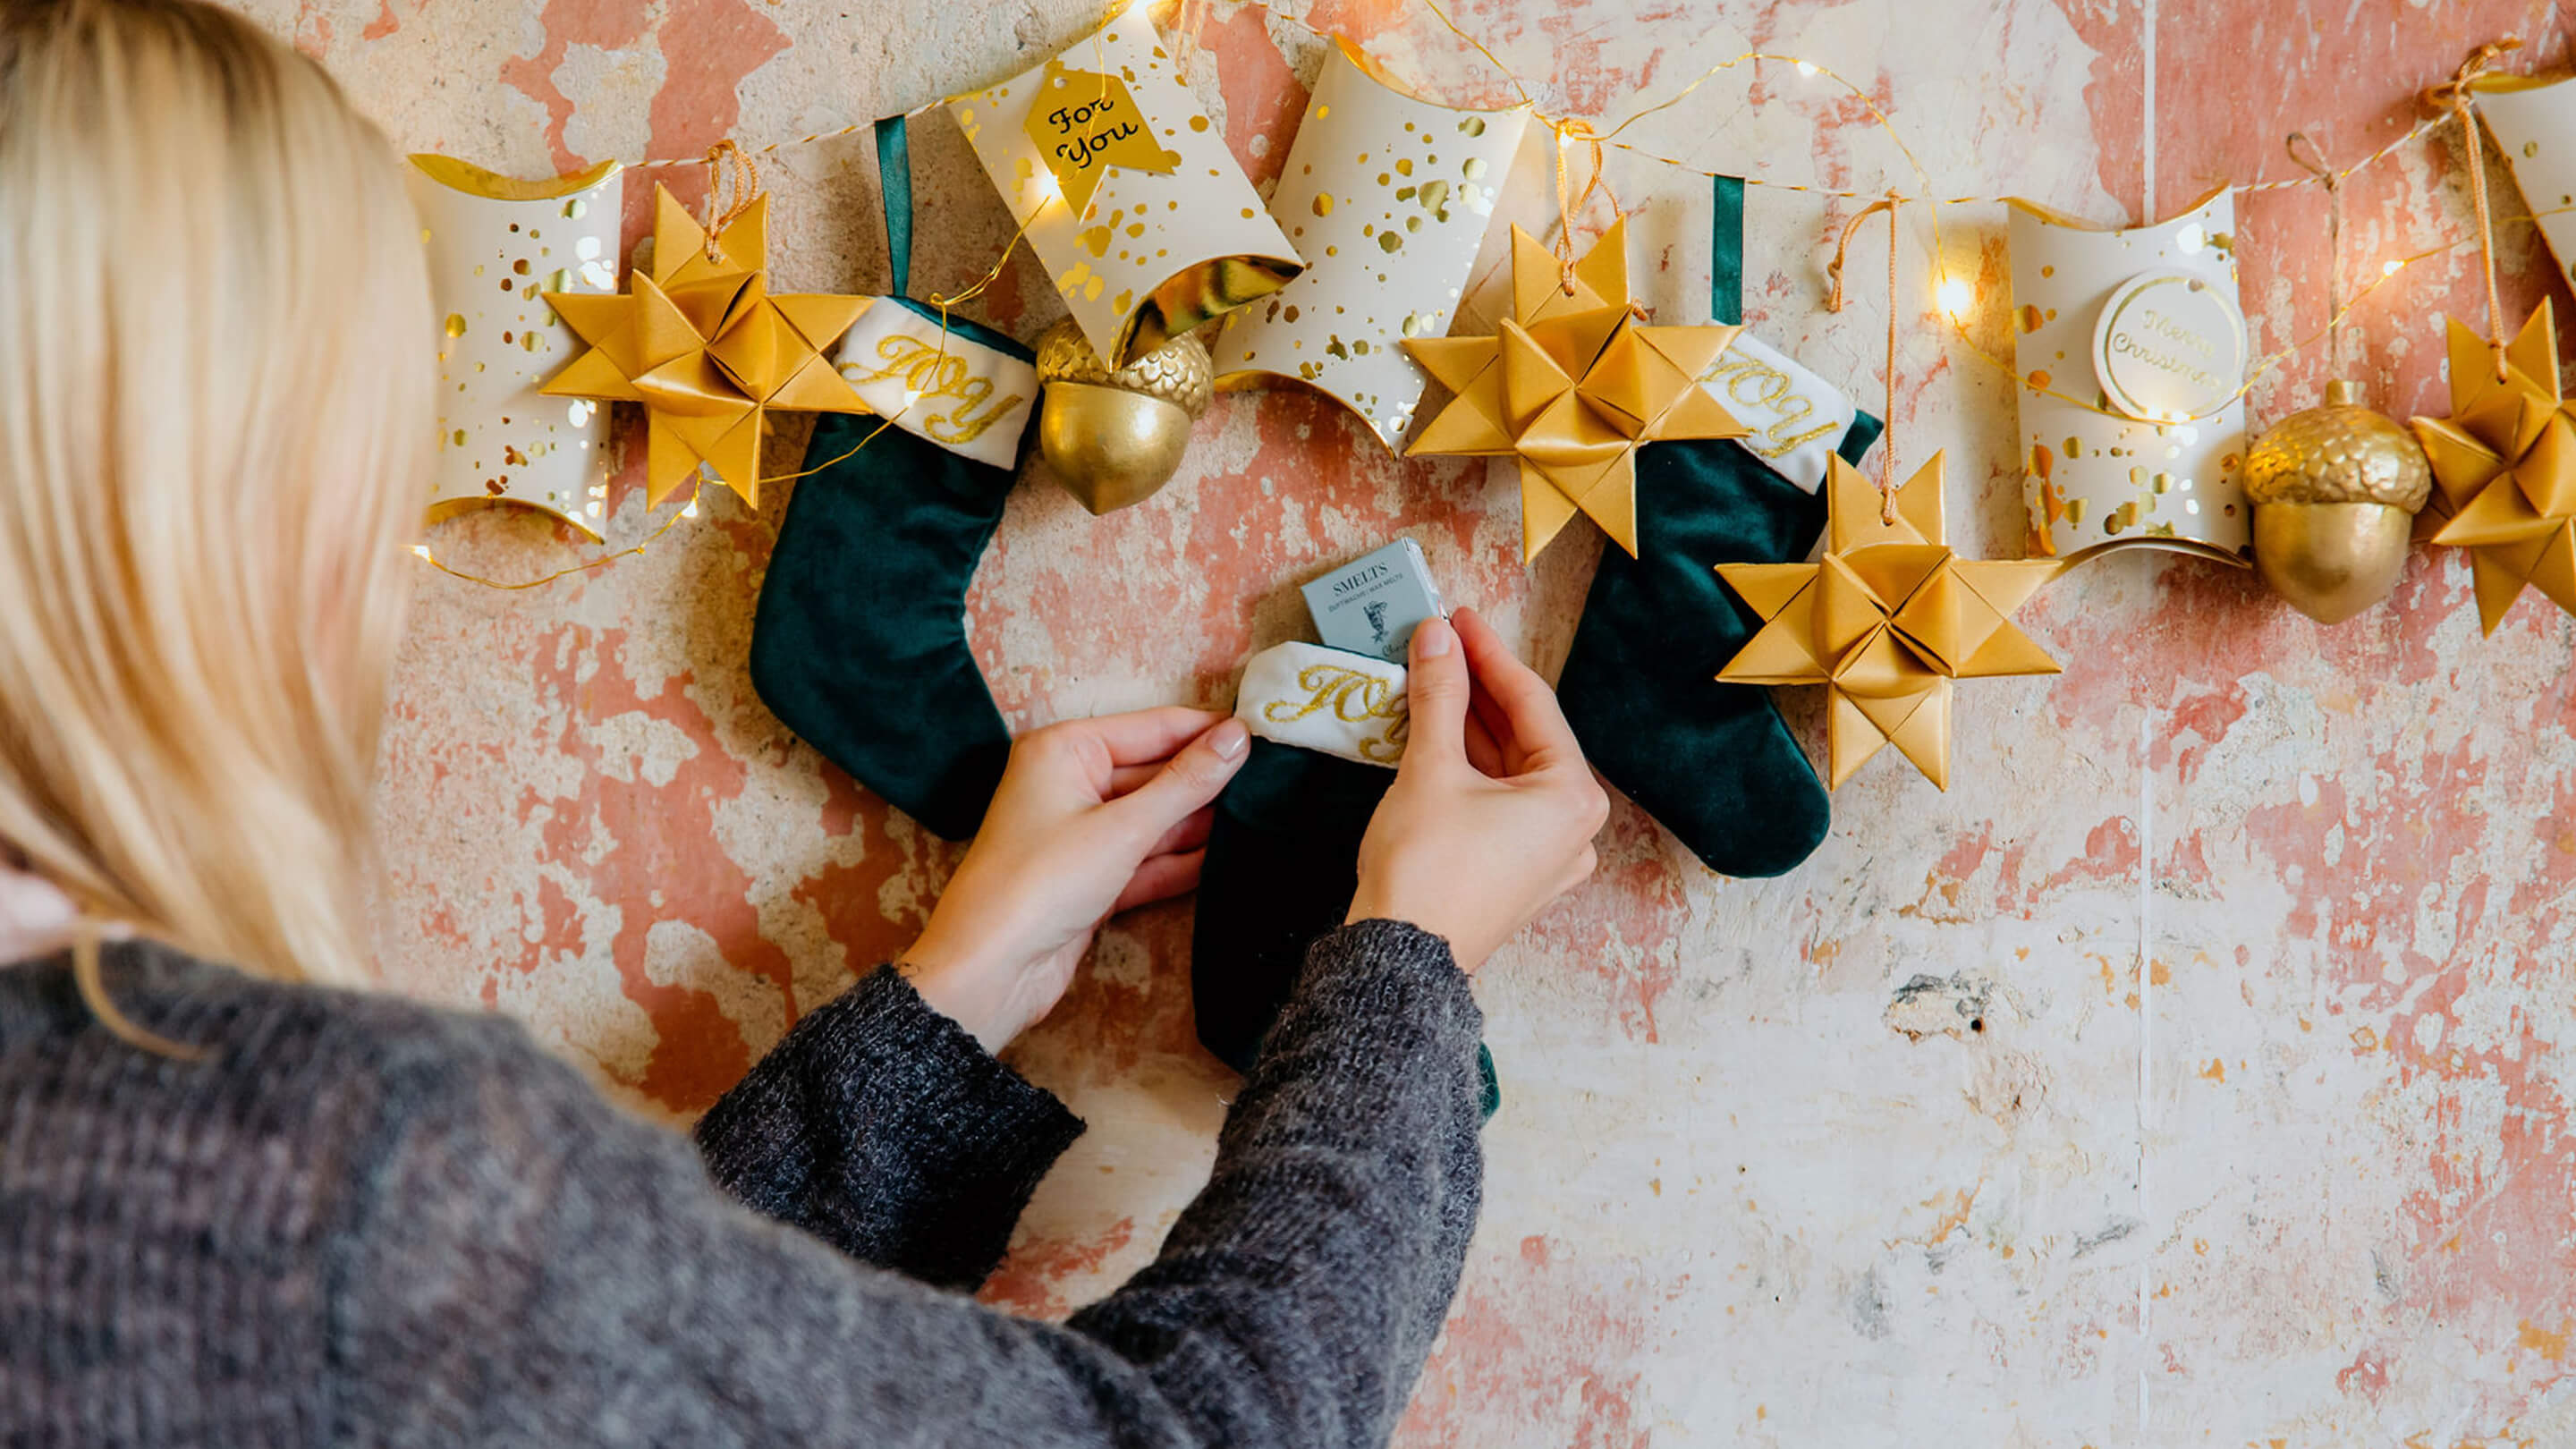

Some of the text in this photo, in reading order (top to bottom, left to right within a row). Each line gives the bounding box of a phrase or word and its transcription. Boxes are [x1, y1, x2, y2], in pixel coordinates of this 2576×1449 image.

[1048, 97, 1114, 134] For
[1055, 121, 1139, 169] You
[2142, 309, 2216, 359] Merry
[2113, 332, 2221, 387] Christmas
[1331, 561, 1390, 597] SMELTS
